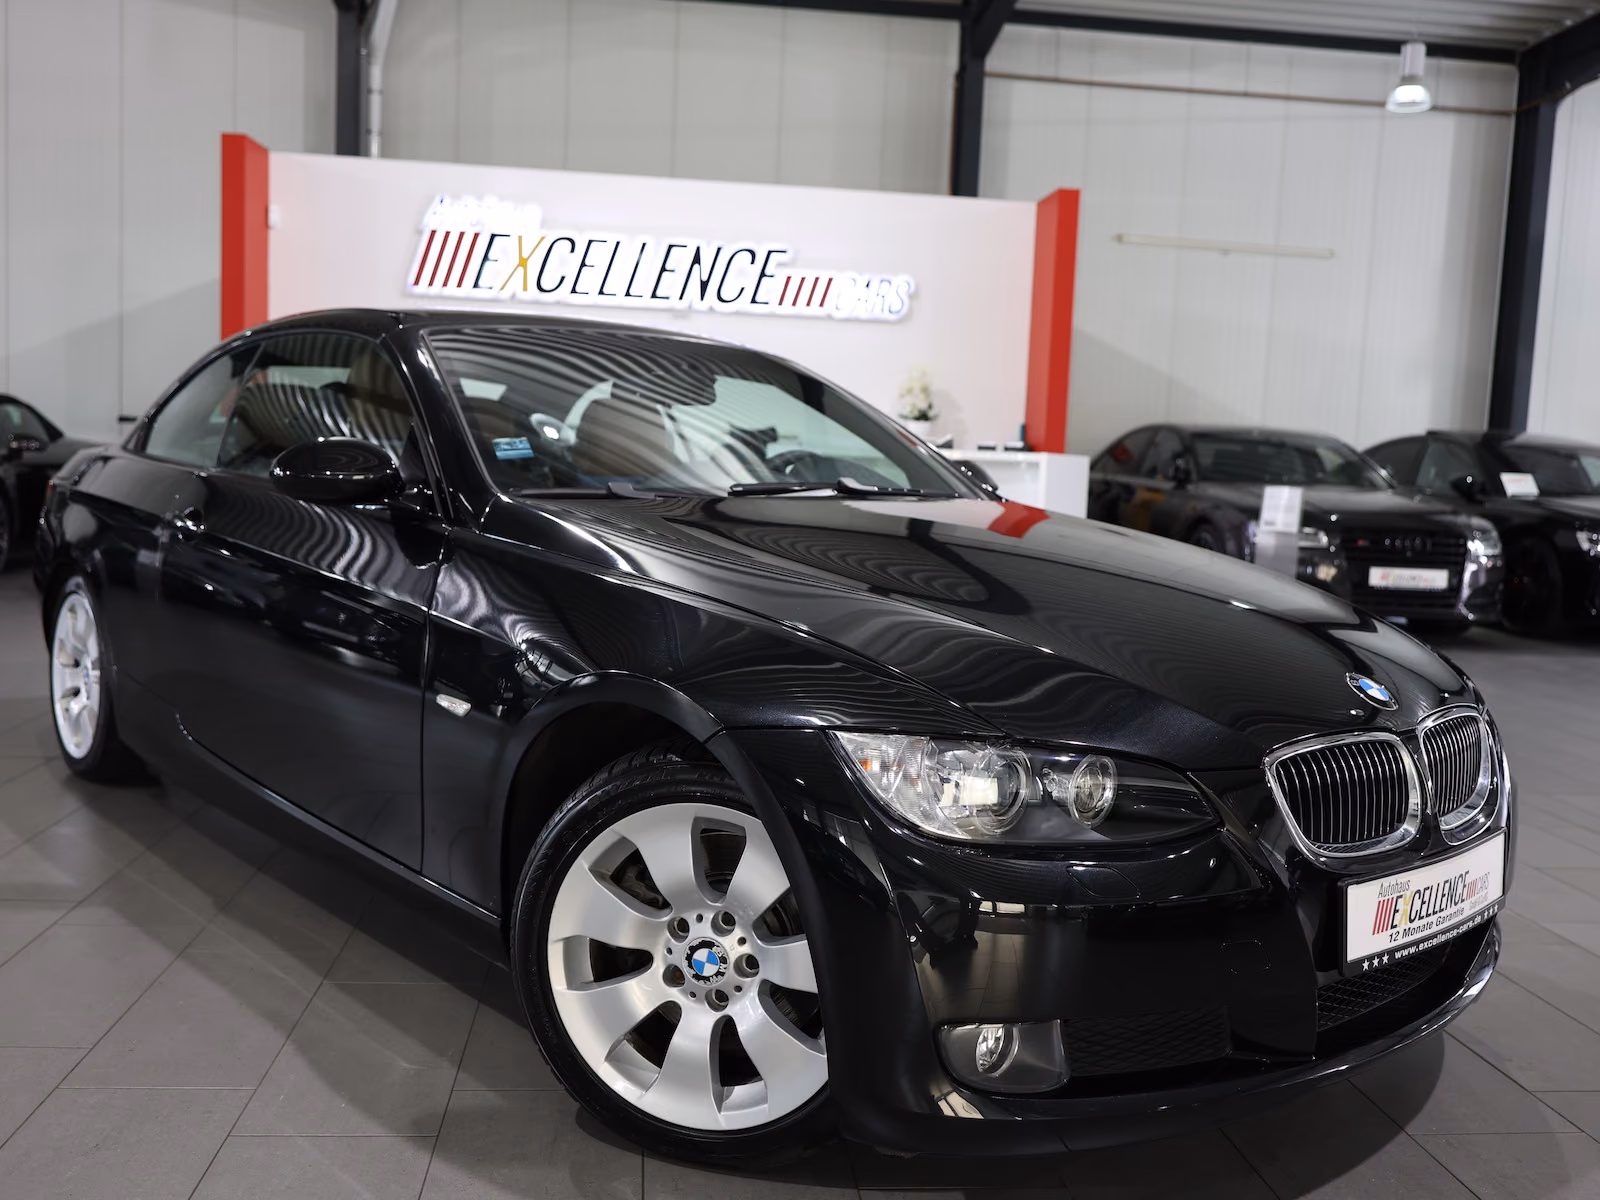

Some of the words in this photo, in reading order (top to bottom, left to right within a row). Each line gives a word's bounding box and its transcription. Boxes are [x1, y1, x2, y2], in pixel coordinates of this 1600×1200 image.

[473, 233, 787, 306] EXCELLENCE
[835, 277, 911, 314] CARS
[1377, 879, 1411, 898] Autohaus
[1390, 870, 1469, 930] EXCELLENCE
[1388, 930, 1400, 943] 12
[1402, 920, 1433, 939] Monate
[1435, 907, 1465, 927] Garantie
[1394, 914, 1482, 959] www.excellence-cars.de
